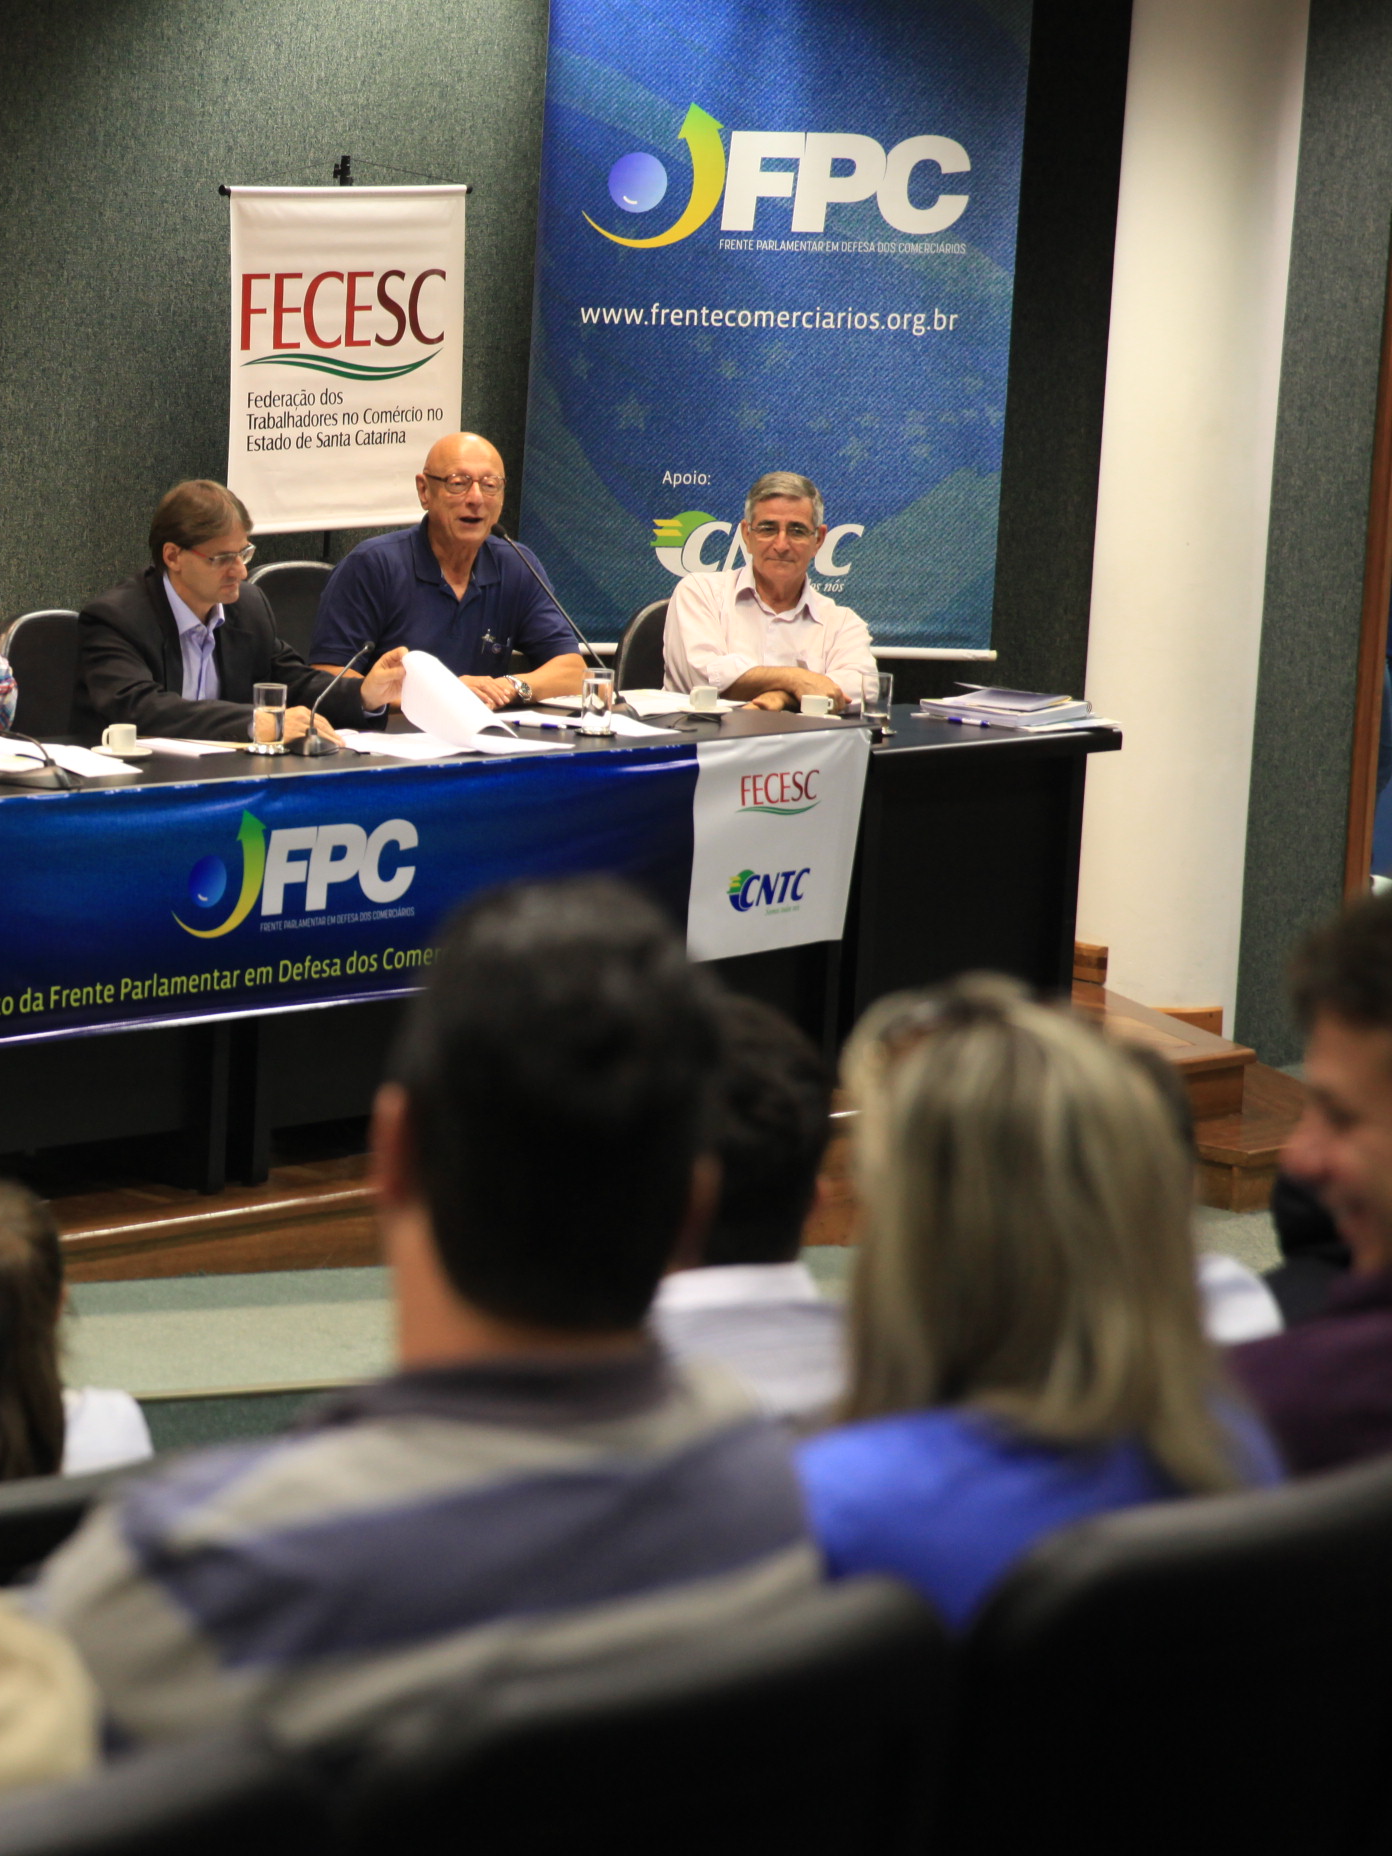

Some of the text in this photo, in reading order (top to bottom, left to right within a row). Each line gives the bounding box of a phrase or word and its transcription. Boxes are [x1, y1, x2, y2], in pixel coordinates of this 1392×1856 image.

[720, 130, 972, 235] FPC
[719, 238, 966, 255] FRENTE PARLAMENTAR EM DEFESA DOS COMERCIÁRIOS
[240, 268, 446, 351] FECESC
[580, 303, 959, 336] www.frentecomerciarios.org.br
[247, 388, 344, 411] Federação dos
[246, 405, 444, 431] Trabalhadores no Comércio no
[246, 427, 407, 452] Estado de Santa Catarina
[662, 470, 711, 488] Apoio:
[823, 578, 845, 592] nós
[740, 769, 820, 806] FECESC
[261, 818, 419, 916] FPC
[739, 867, 811, 909] CNTC
[260, 906, 415, 932] FRENTE PARLAMENTAR EM DEFESA DOS COMERCIÁRIOS
[18, 988, 44, 1011] da
[50, 982, 114, 1009] Frente
[120, 968, 240, 1000] Parlamentar
[244, 965, 273, 986] em
[278, 956, 342, 983] Defesa
[346, 950, 378, 975] dos
